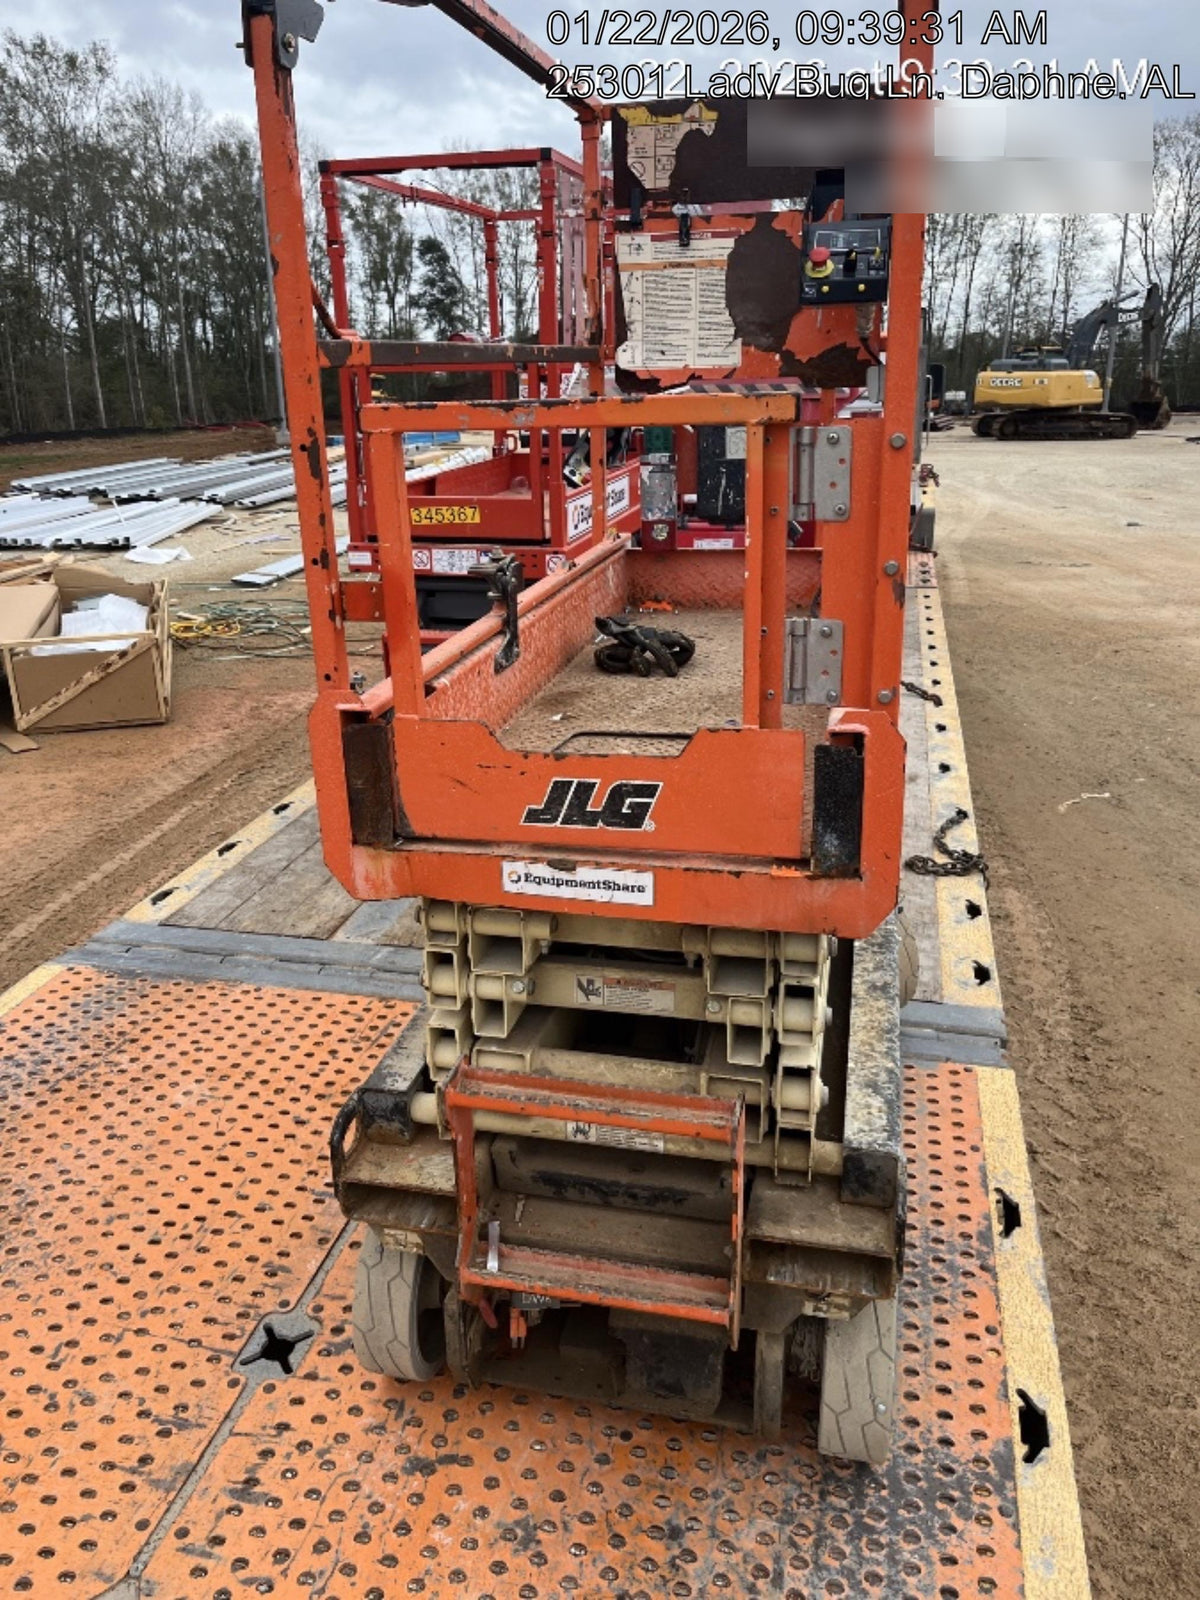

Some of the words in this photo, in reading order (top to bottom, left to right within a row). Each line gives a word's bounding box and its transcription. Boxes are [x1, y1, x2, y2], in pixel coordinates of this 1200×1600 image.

[412, 506, 477, 523] 345367
[520, 778, 664, 831] JLG
[523, 872, 646, 894] EquipmentShare
